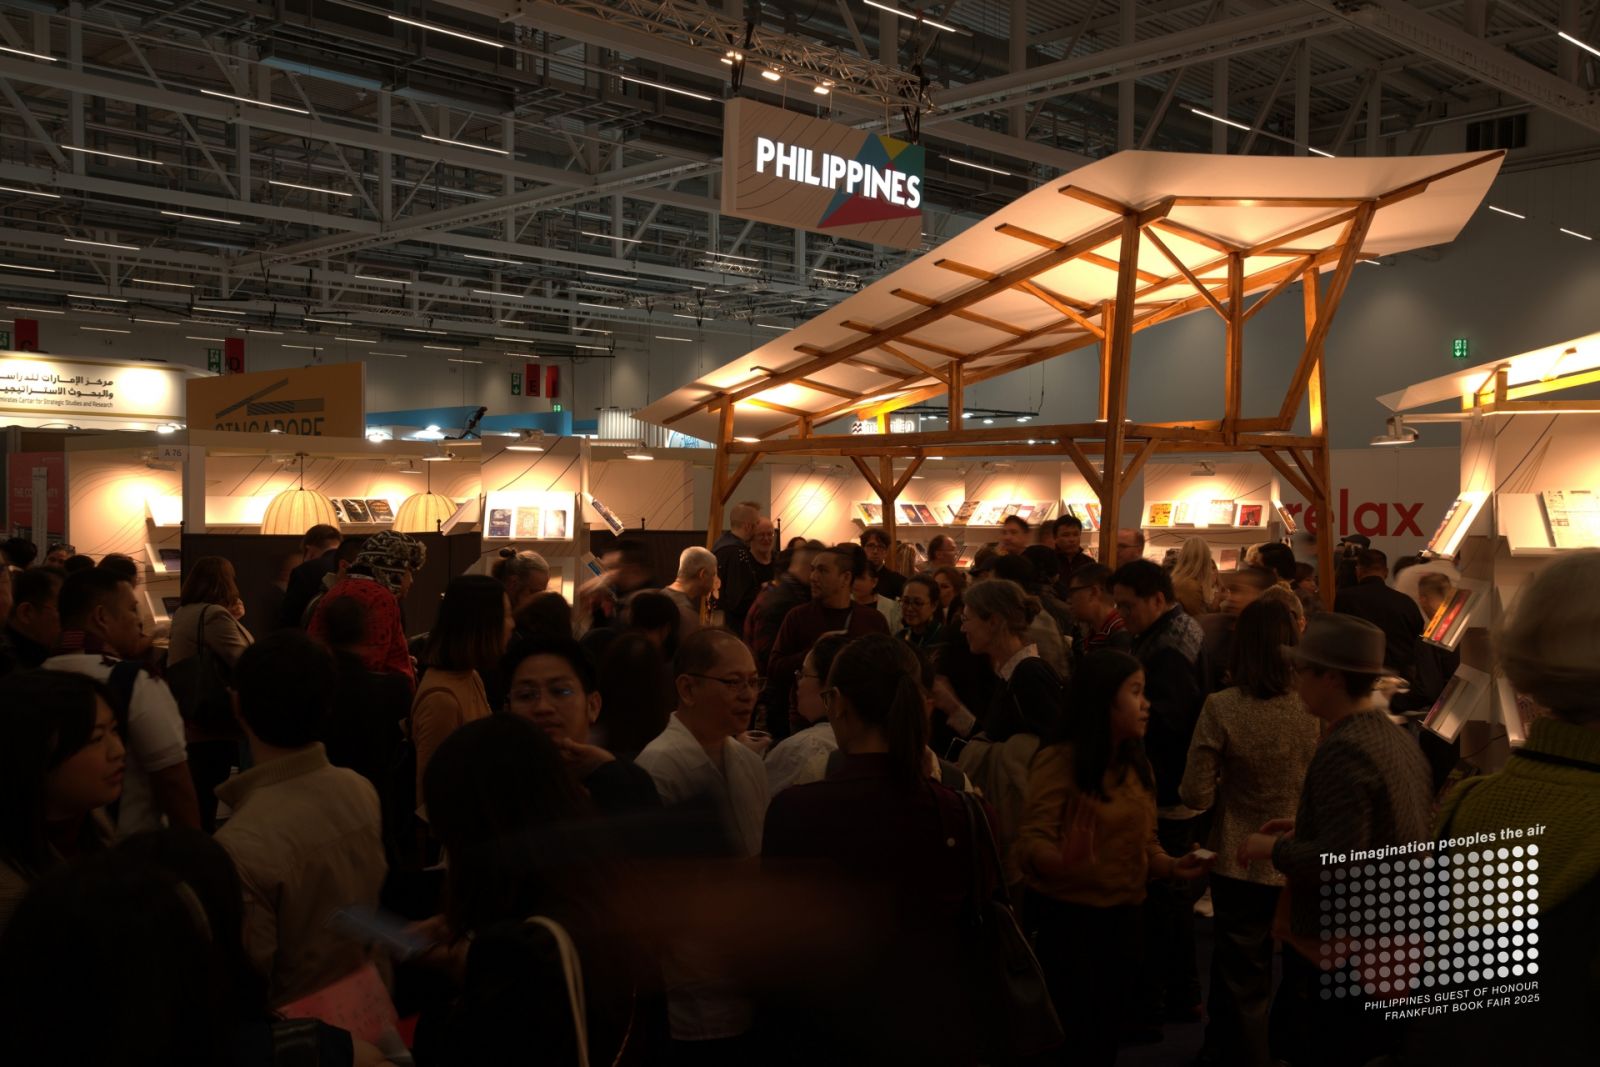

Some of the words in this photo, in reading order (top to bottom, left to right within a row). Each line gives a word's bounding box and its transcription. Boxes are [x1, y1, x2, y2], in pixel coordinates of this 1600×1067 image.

[756, 136, 920, 209] PHILIPPINES
[0, 372, 39, 381] للدراس
[41, 374, 84, 386] الإمارات
[85, 377, 114, 387] مركز
[0, 385, 66, 396] الاستراتيجي
[67, 387, 114, 399] والبحوث
[165, 448, 171, 457] A
